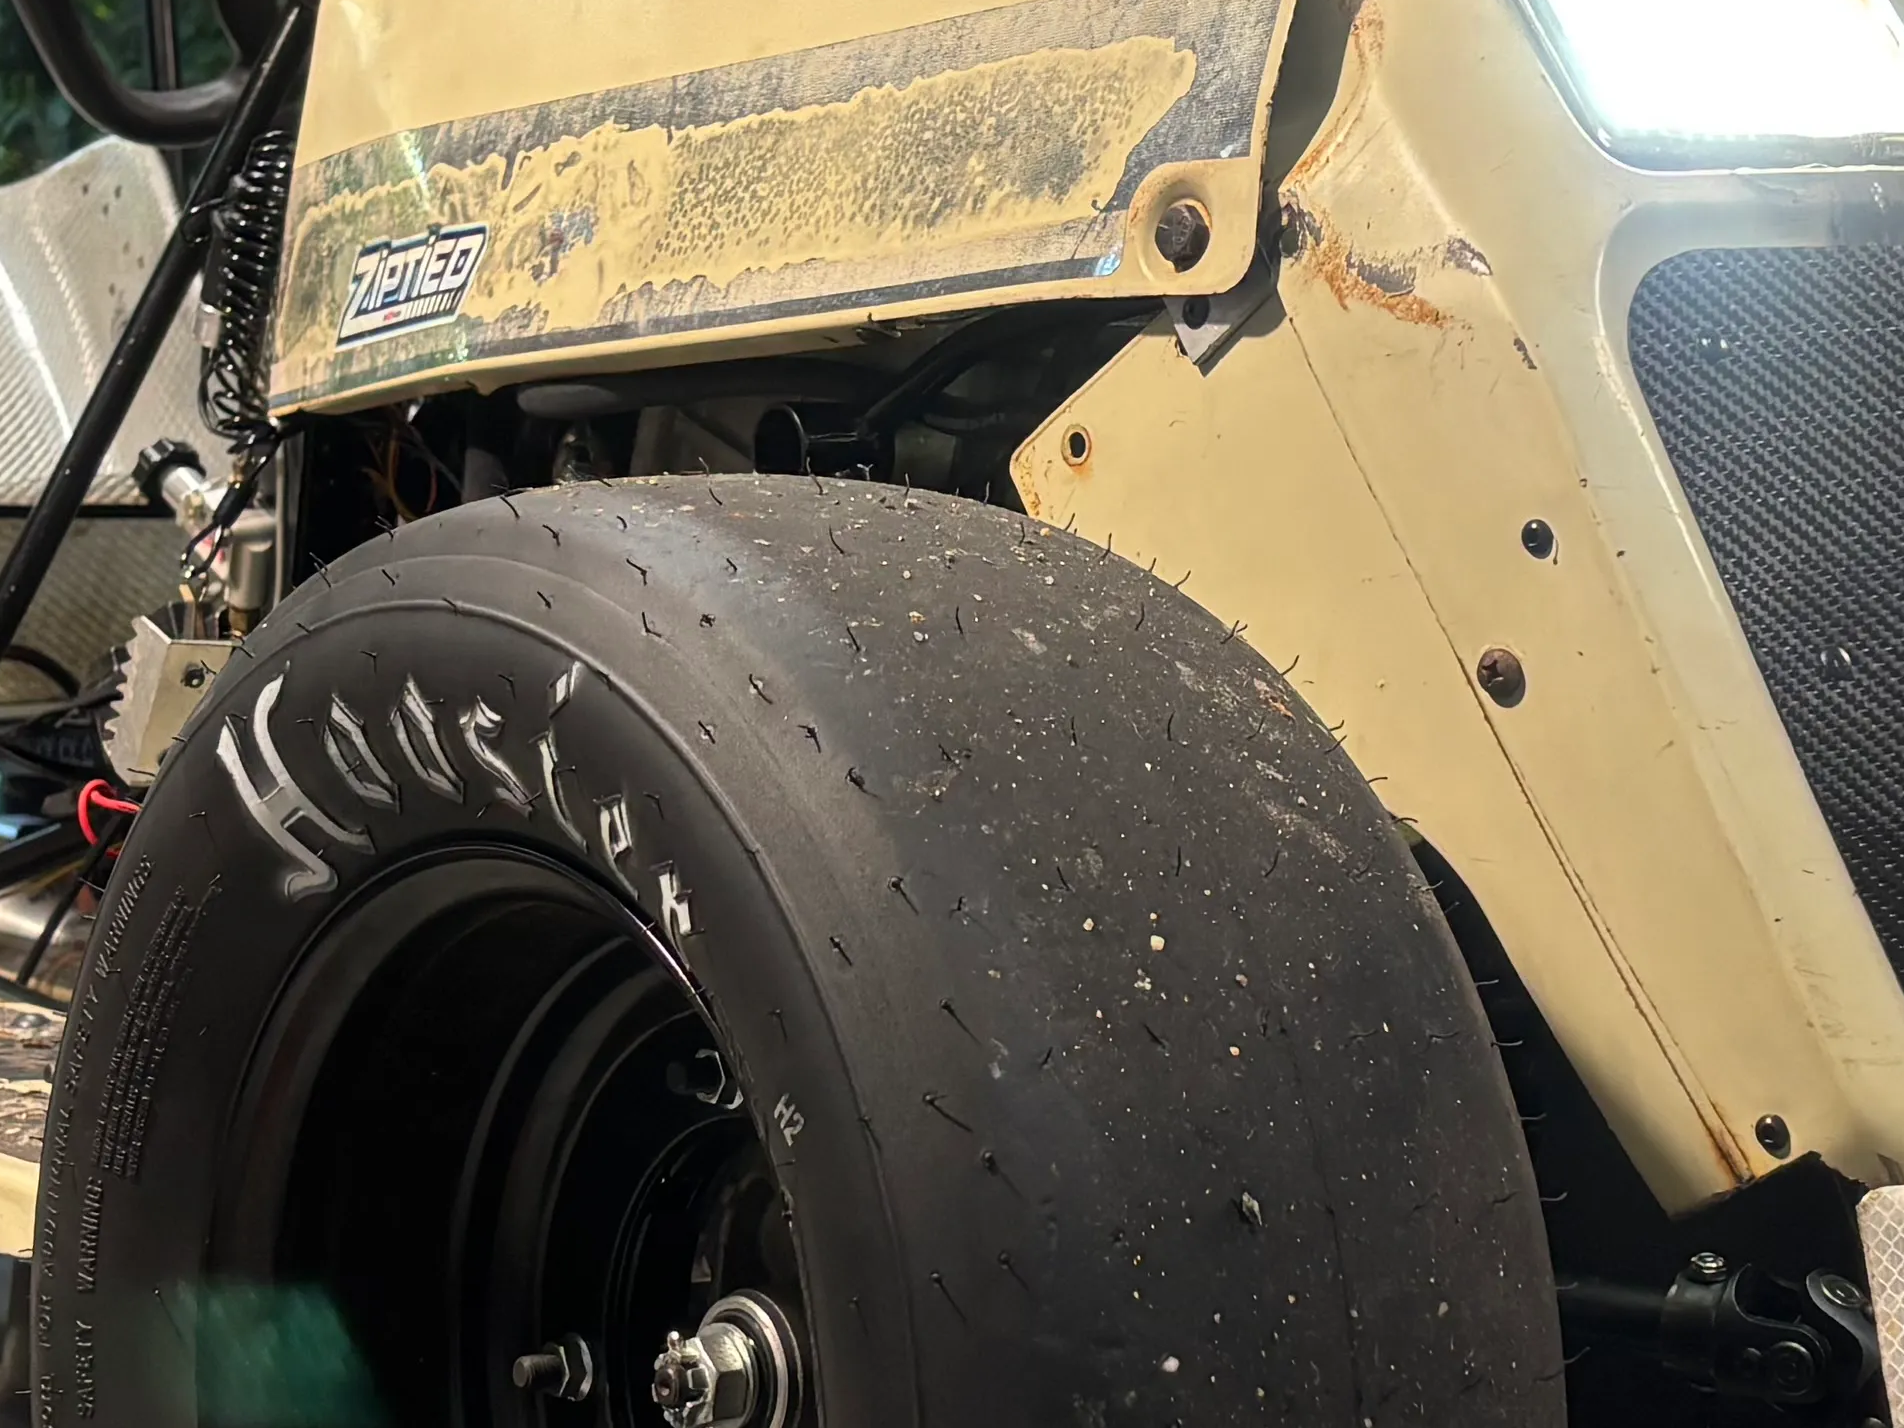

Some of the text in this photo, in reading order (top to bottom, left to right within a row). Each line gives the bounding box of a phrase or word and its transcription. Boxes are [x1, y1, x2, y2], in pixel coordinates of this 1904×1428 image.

[64, 983, 99, 1096] SAFETY
[773, 1092, 805, 1147] H2
[75, 1319, 95, 1420] SAFETY
